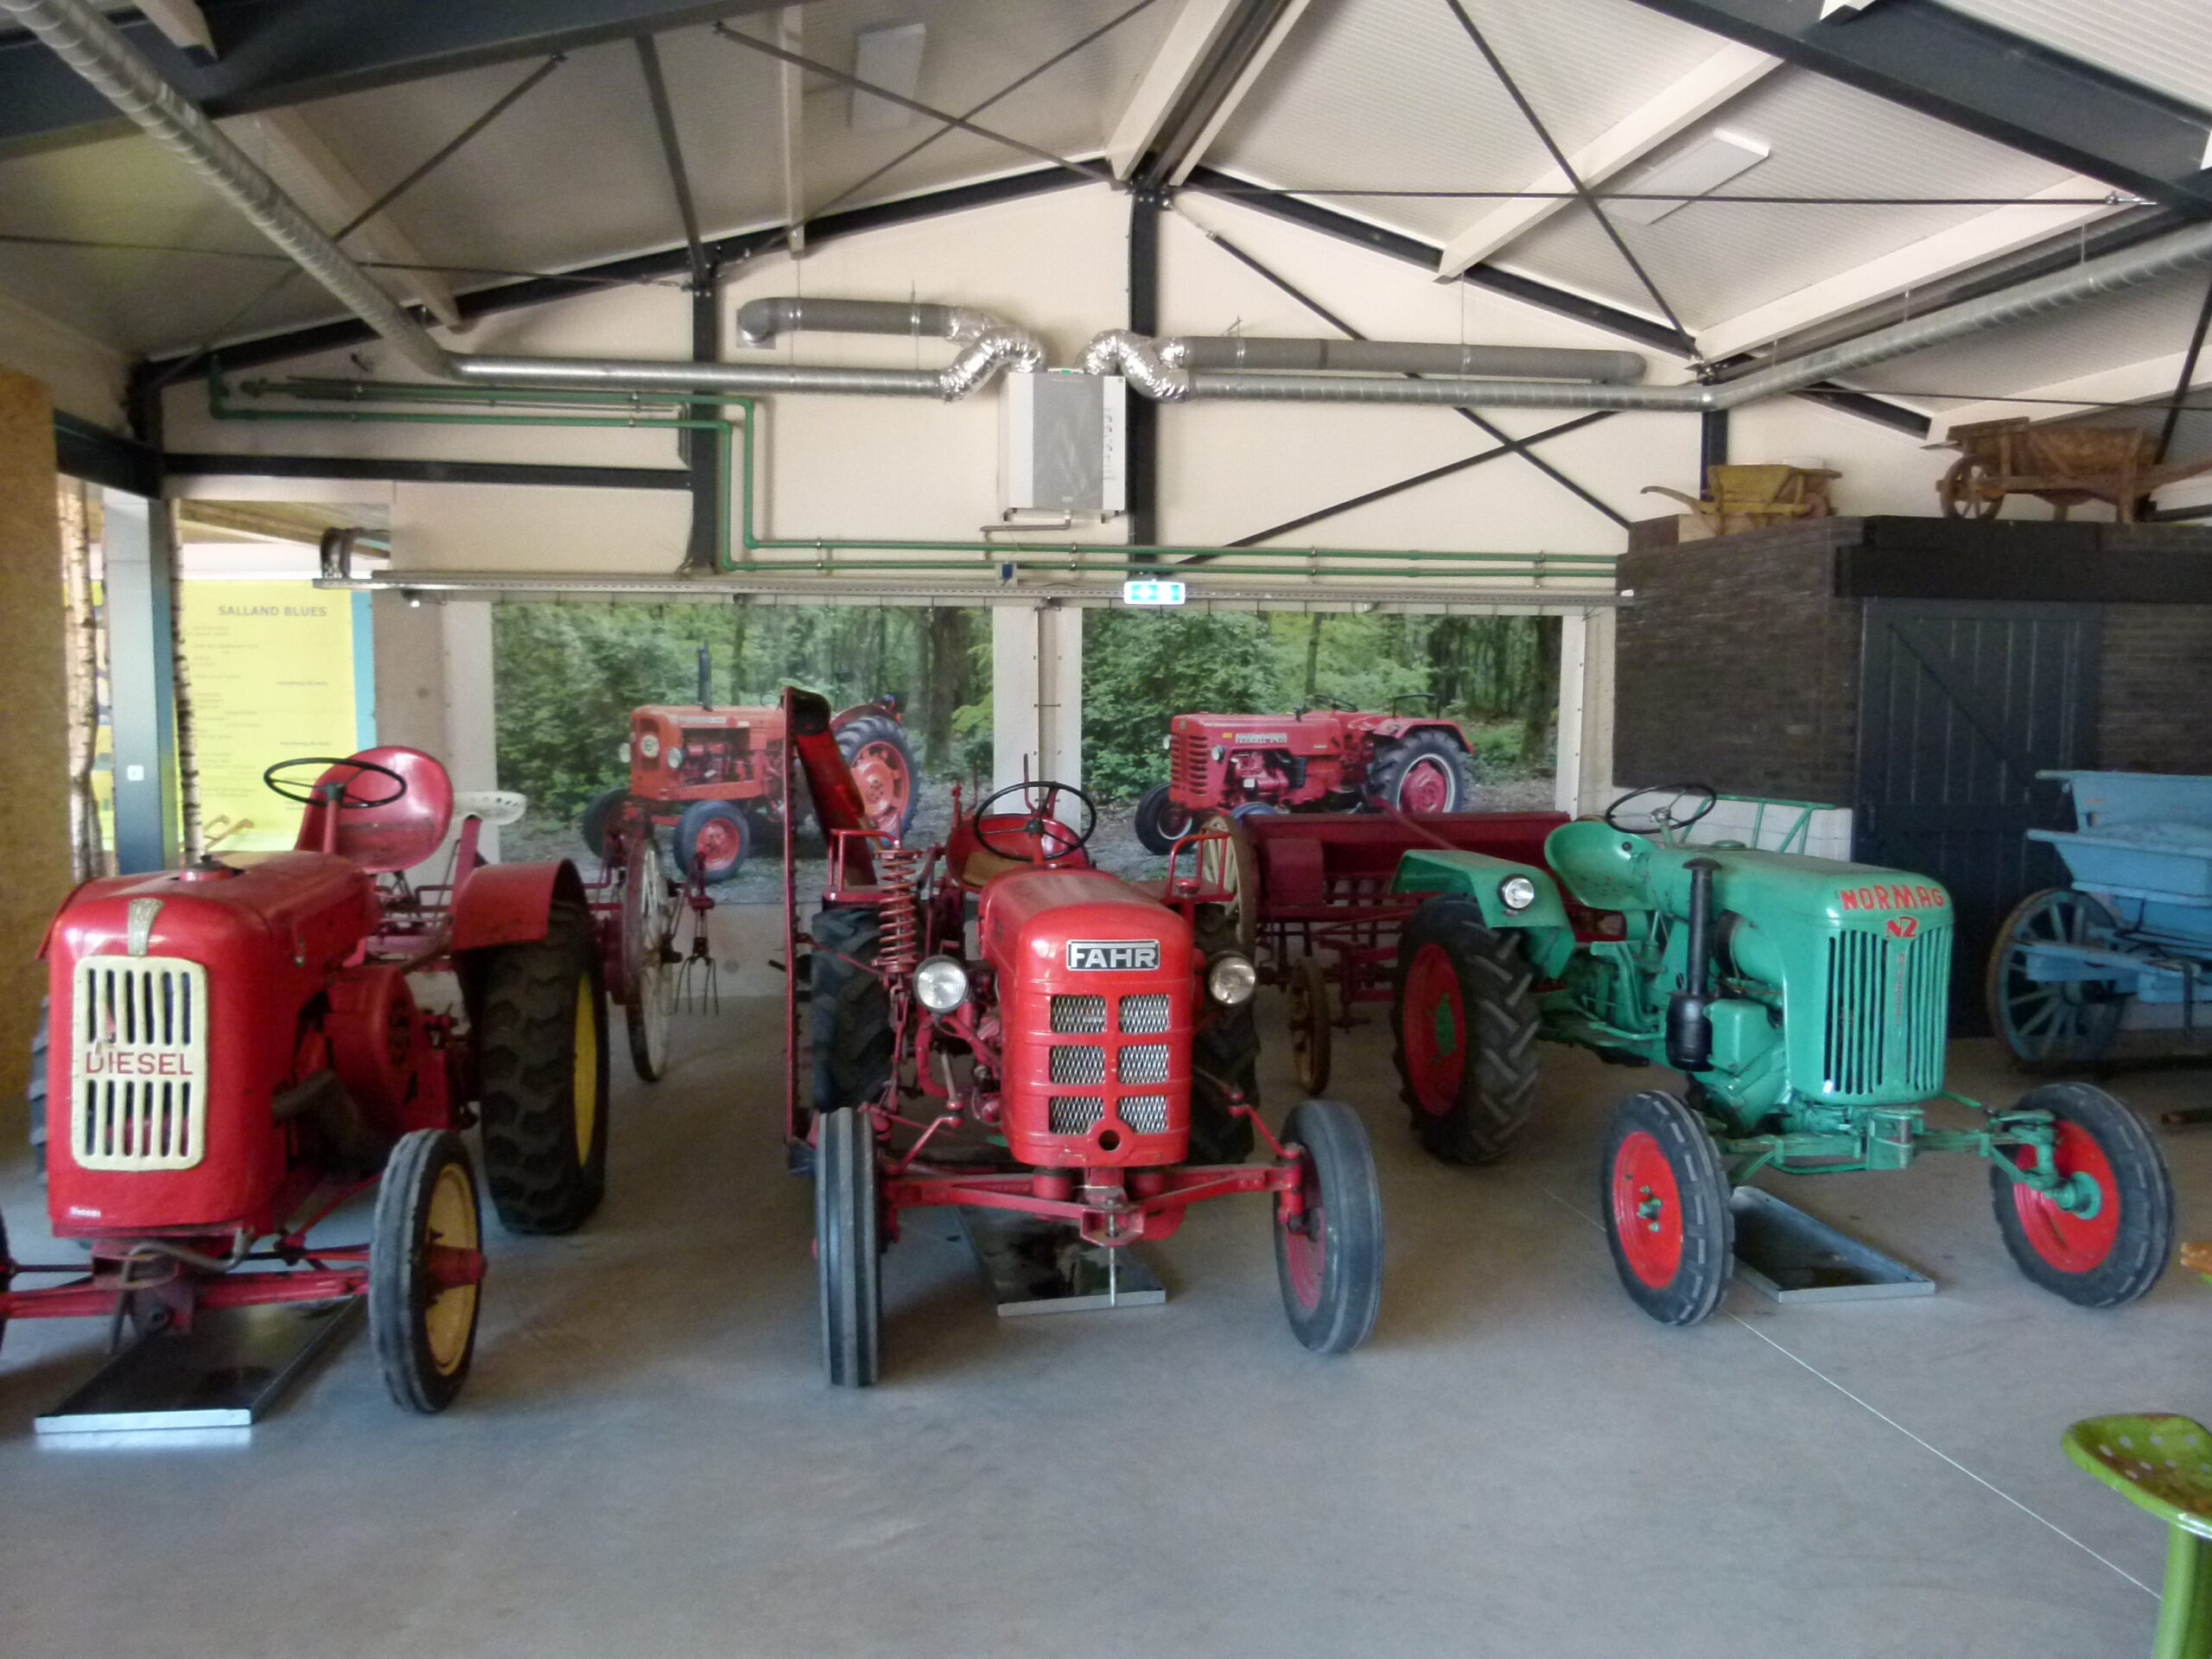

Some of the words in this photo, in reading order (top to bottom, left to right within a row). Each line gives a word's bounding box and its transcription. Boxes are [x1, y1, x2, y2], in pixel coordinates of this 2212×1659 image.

[219, 605, 279, 616] SALLAND
[284, 606, 327, 617] BLUES
[1840, 884, 1944, 910] NORMAG
[1071, 943, 1156, 968] FAHR
[86, 1051, 193, 1076] DIESEL
